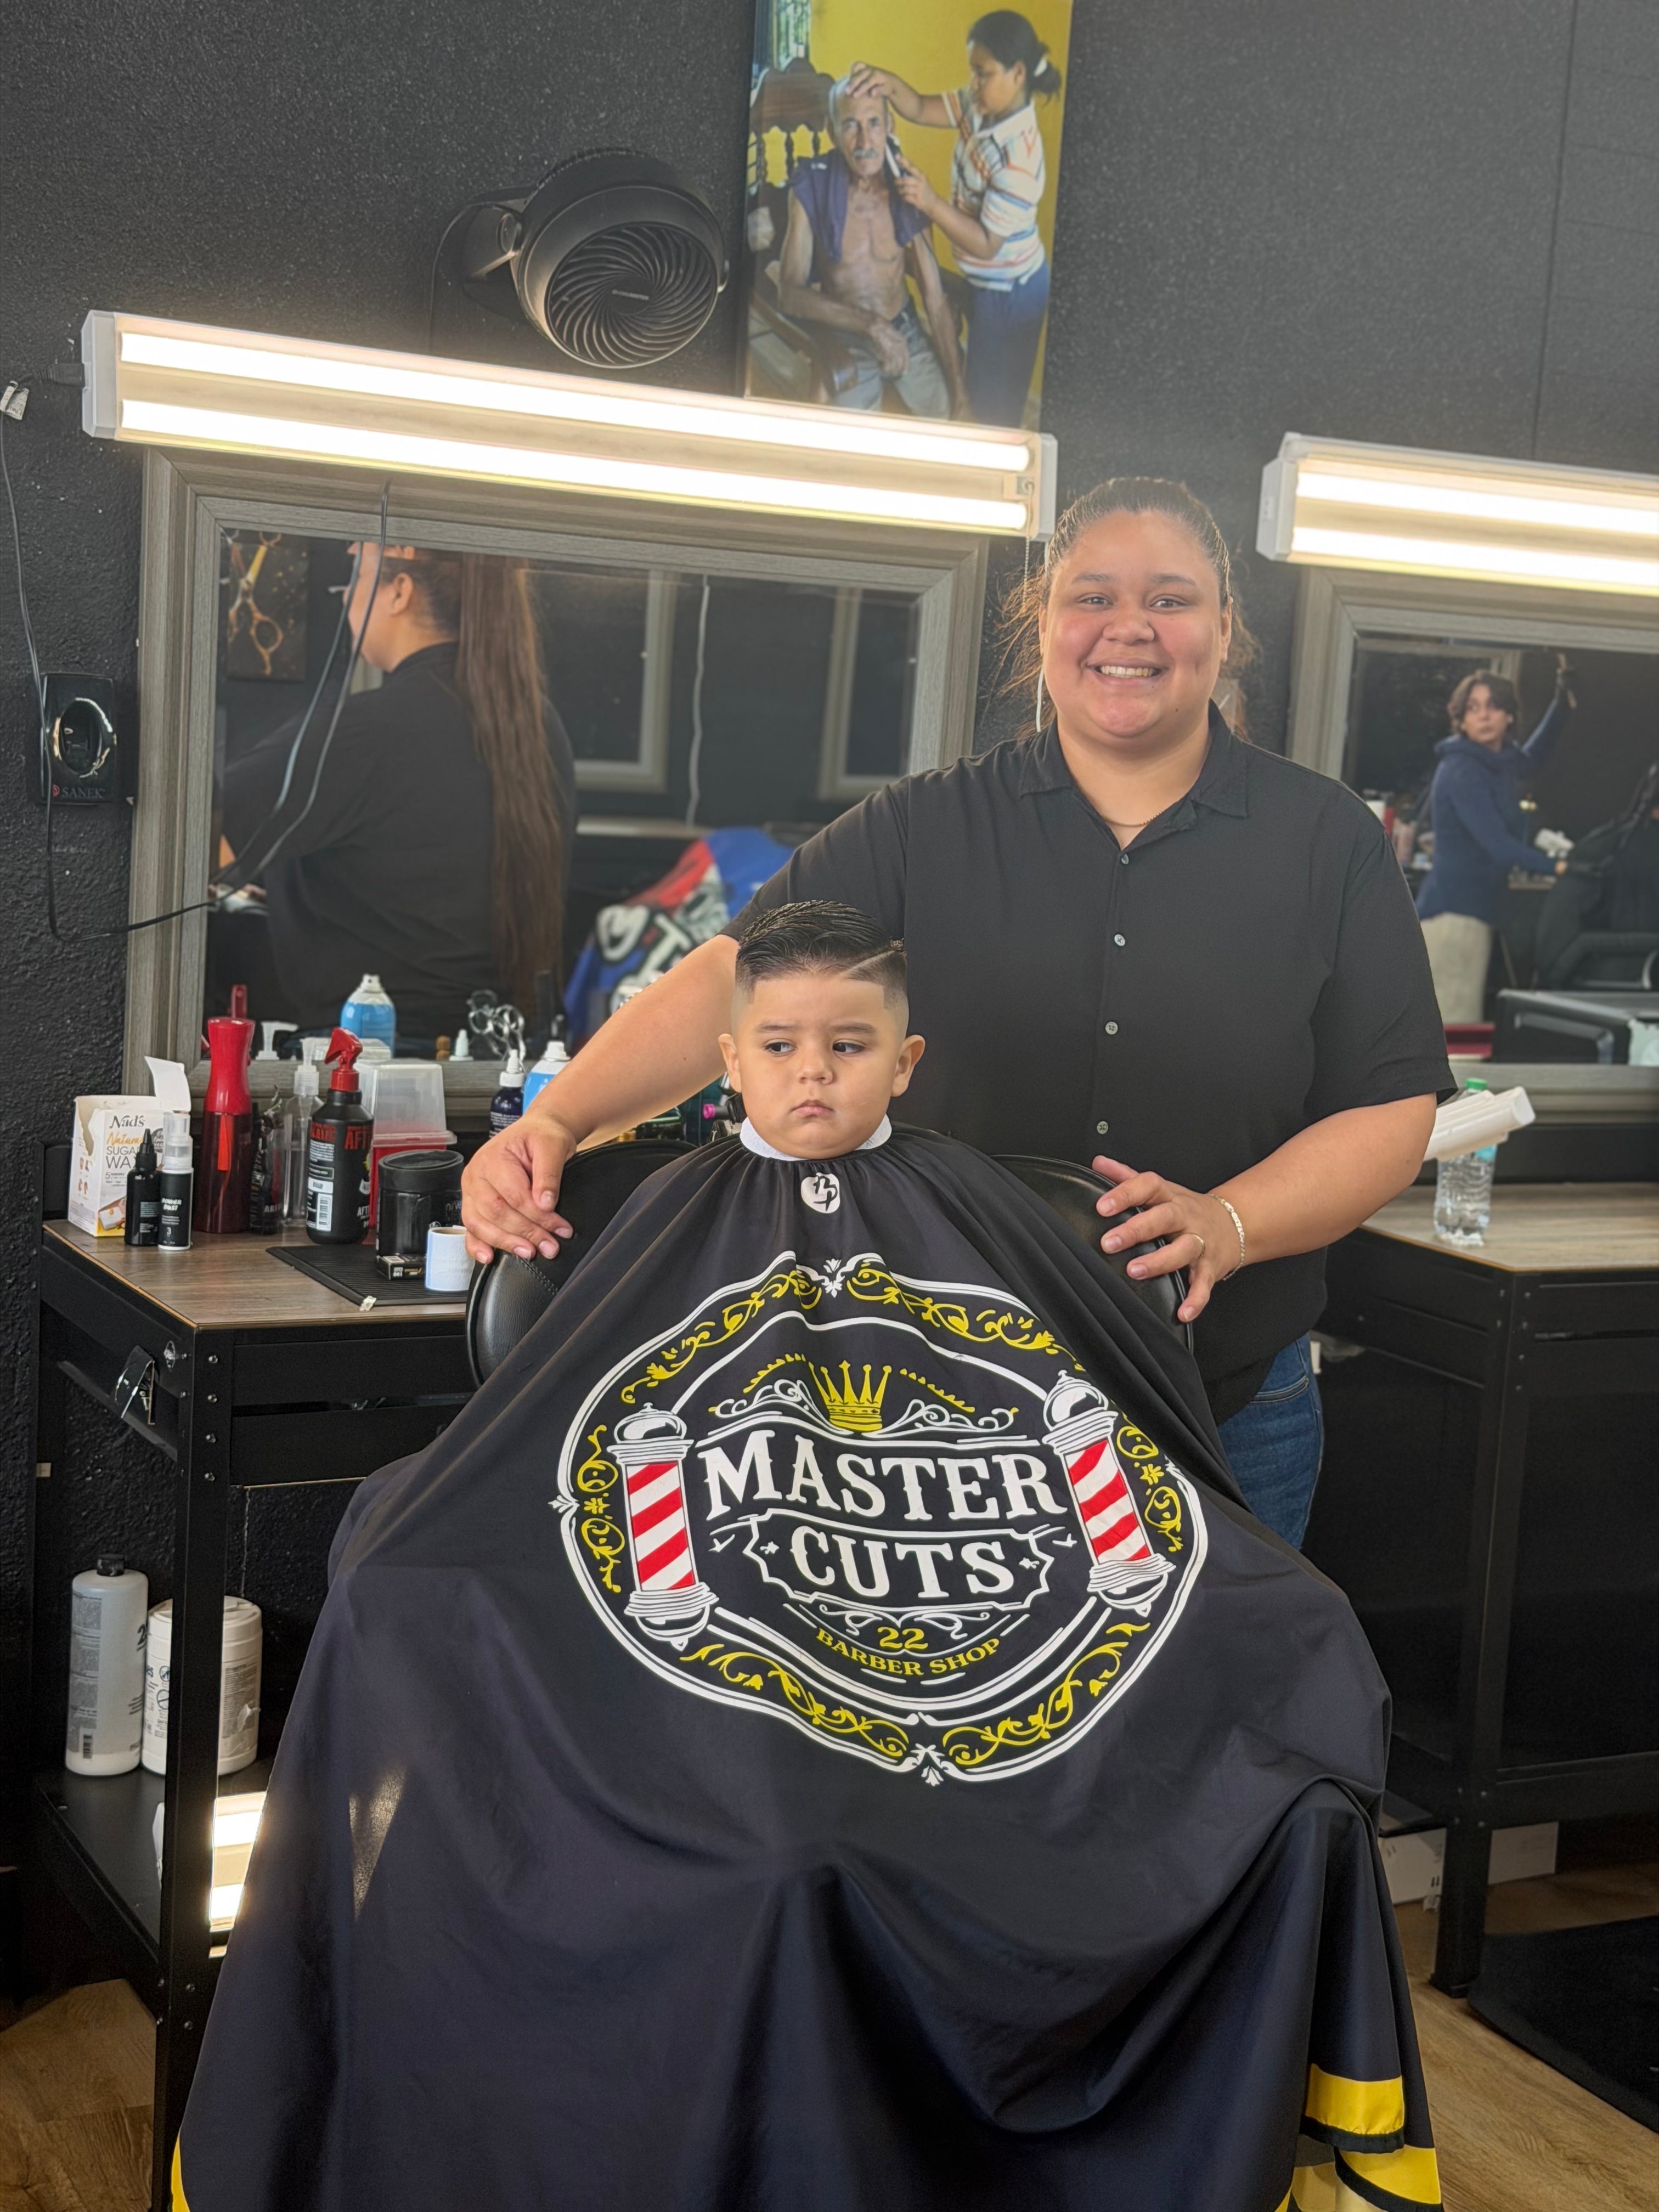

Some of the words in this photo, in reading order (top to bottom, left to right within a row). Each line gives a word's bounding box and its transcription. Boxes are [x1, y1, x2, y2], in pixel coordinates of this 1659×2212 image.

[61, 787, 105, 799] SANEK
[109, 1115, 145, 1128] Nad's
[697, 1430, 1068, 1521] MASTER
[790, 1526, 1014, 1598] CUTS
[816, 1628, 924, 1675] BARBER
[929, 1638, 1000, 1673] SHOP
[877, 1627, 928, 1649] 22
